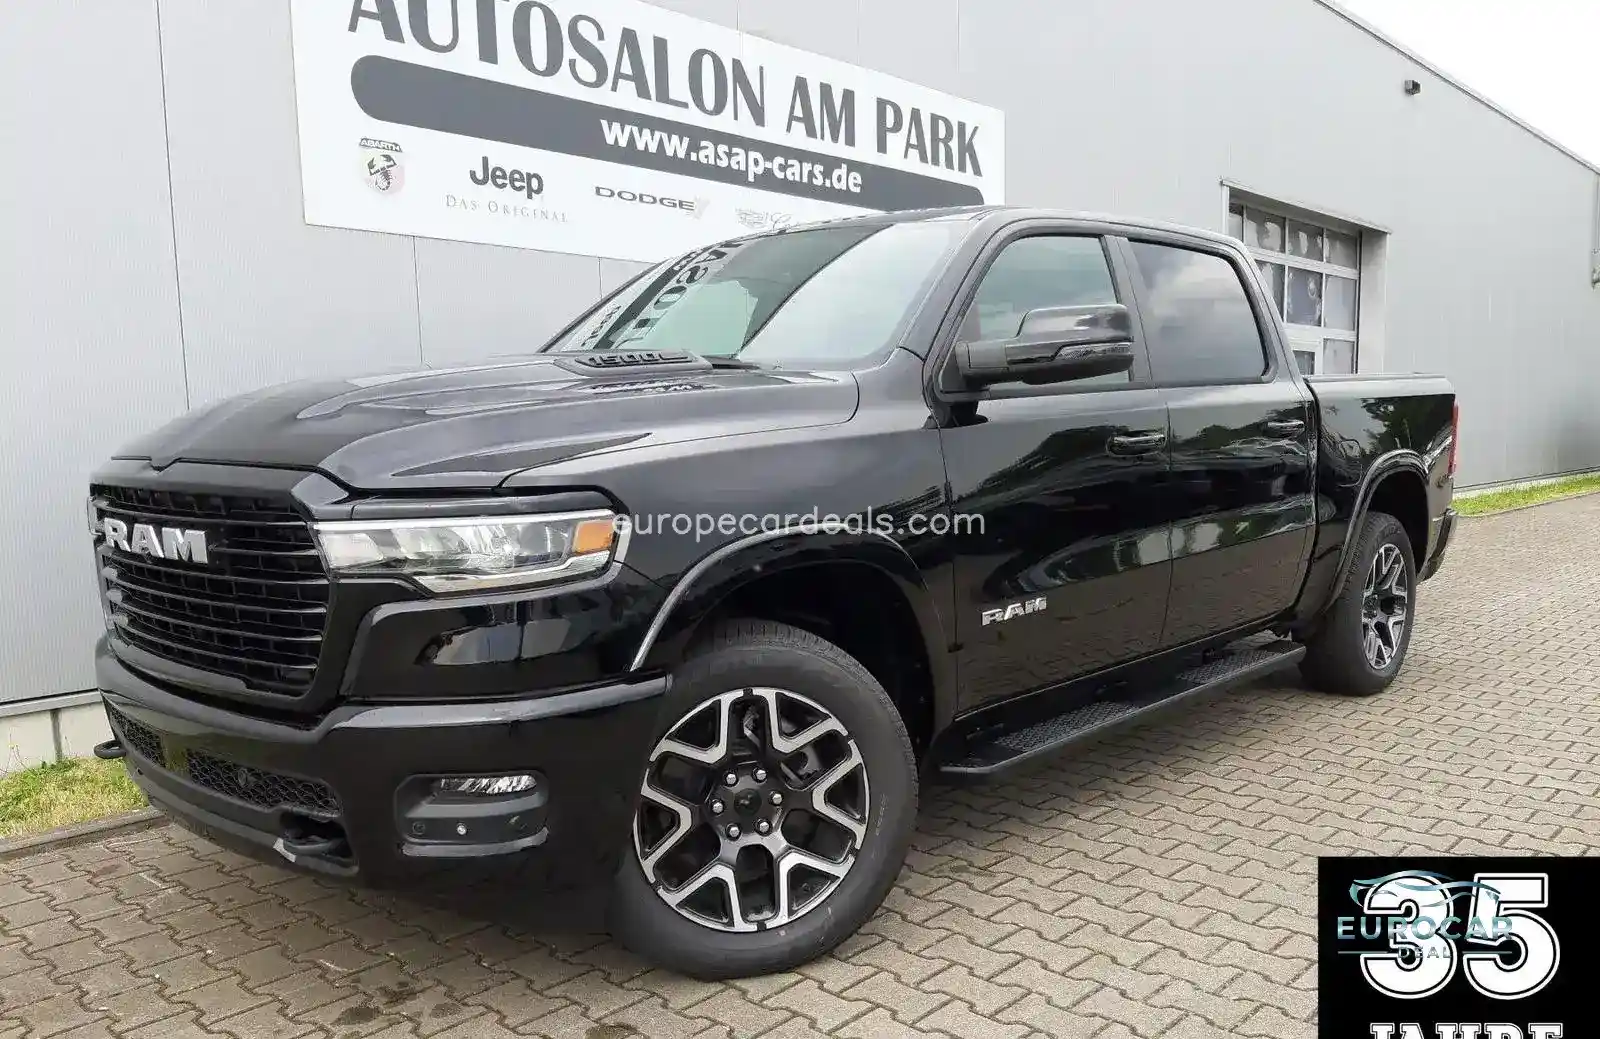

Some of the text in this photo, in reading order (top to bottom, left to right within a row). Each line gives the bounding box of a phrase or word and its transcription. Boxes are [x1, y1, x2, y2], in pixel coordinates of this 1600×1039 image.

[786, 75, 856, 148] AM
[876, 97, 983, 177] PARK
[469, 155, 544, 199] Jeep
[600, 118, 862, 193] www.asap-cars.de
[595, 186, 695, 211] DODGE
[103, 517, 209, 564] RAM
[982, 597, 1047, 626] RAM
